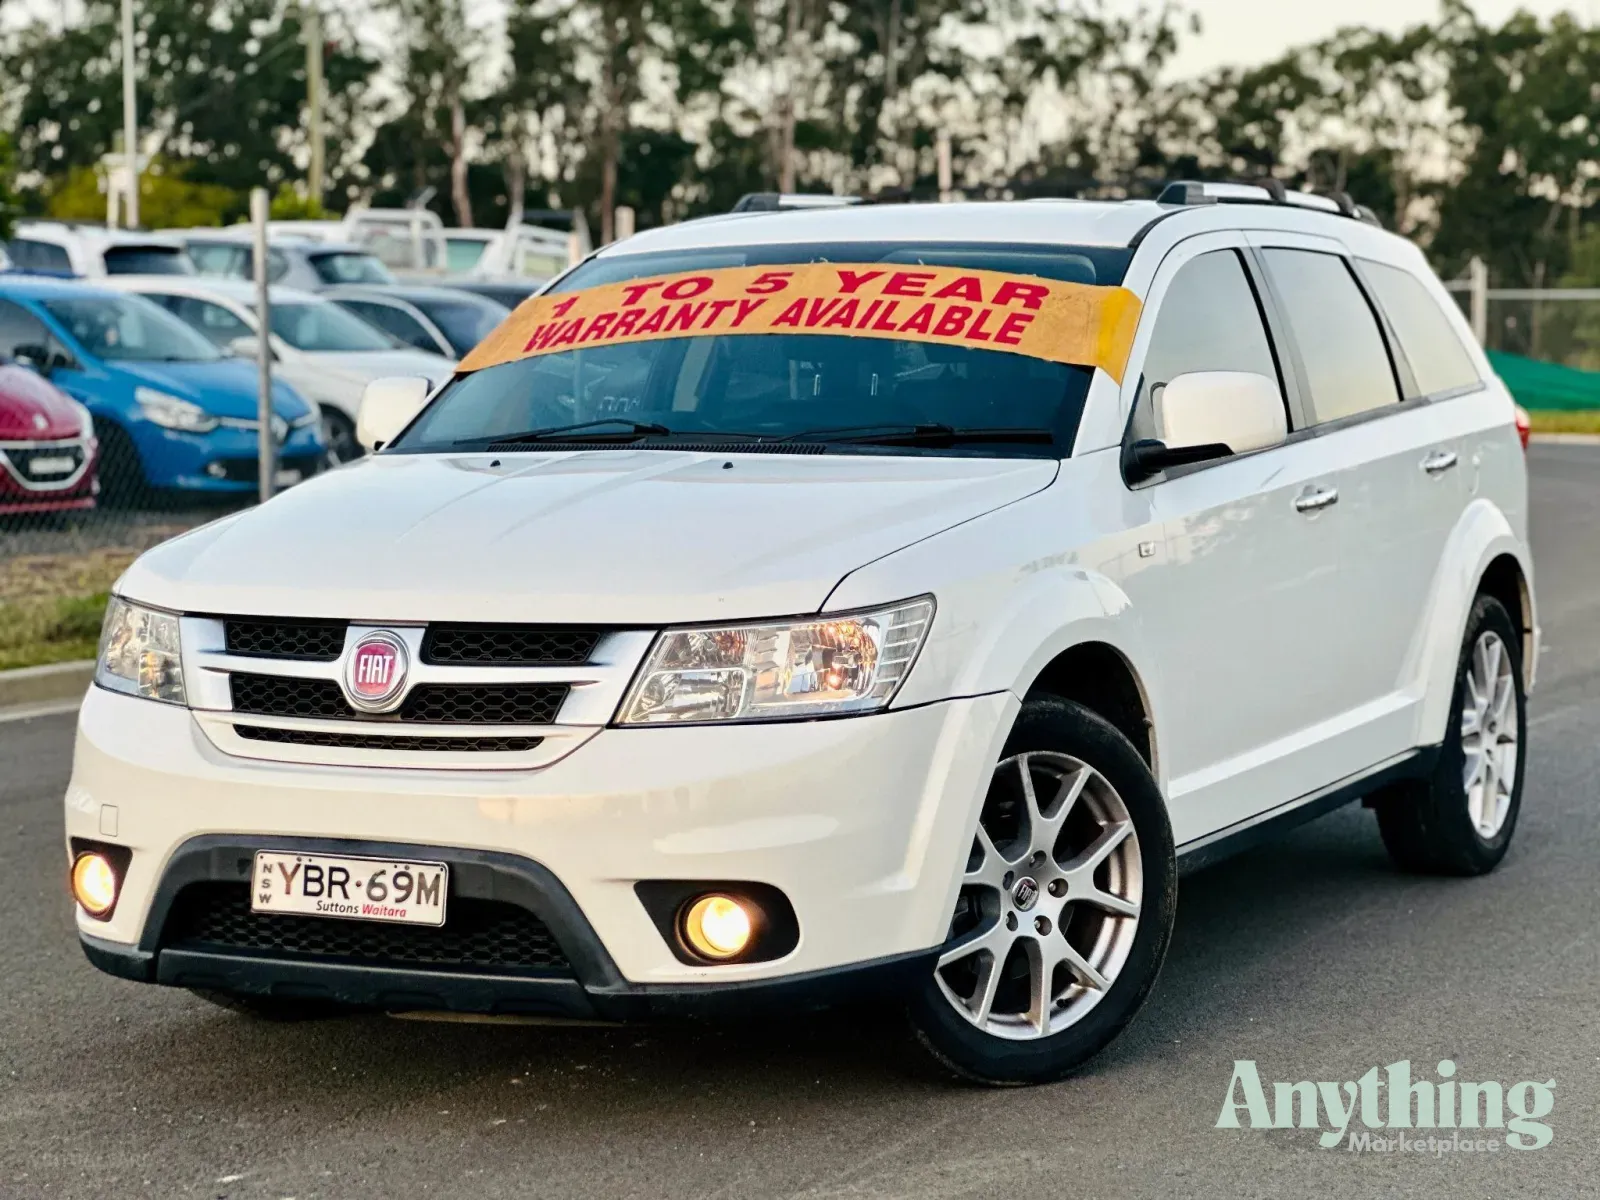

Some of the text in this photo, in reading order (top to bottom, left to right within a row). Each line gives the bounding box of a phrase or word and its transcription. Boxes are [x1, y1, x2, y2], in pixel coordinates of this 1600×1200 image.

[552, 270, 1050, 319] 1 TO 5 YEAR
[522, 297, 1036, 353] WARRANTY AVAILABLE
[358, 654, 393, 684] FIAT
[315, 899, 407, 918] Suttons Waitara
